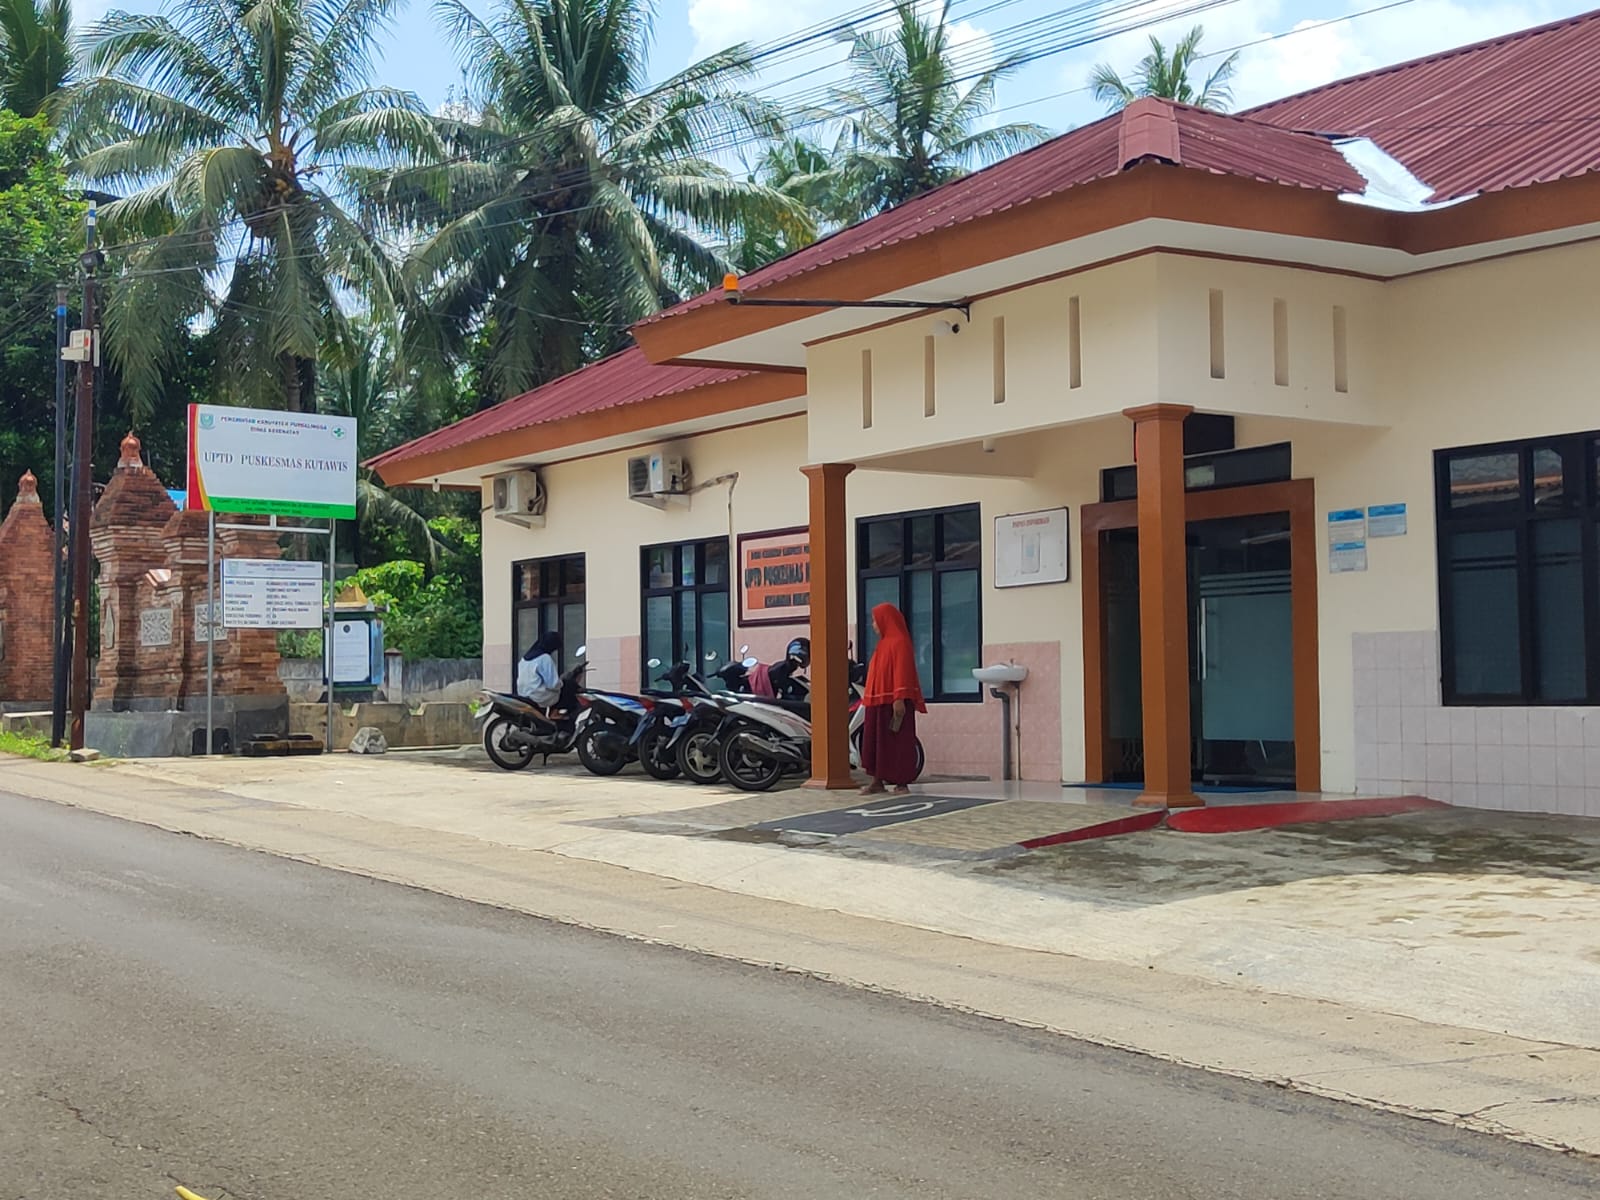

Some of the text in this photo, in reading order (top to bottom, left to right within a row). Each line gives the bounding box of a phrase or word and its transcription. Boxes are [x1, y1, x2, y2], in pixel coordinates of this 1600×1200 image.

[204, 452, 348, 472] UPTD PUSKESMAS KUTAWIS
